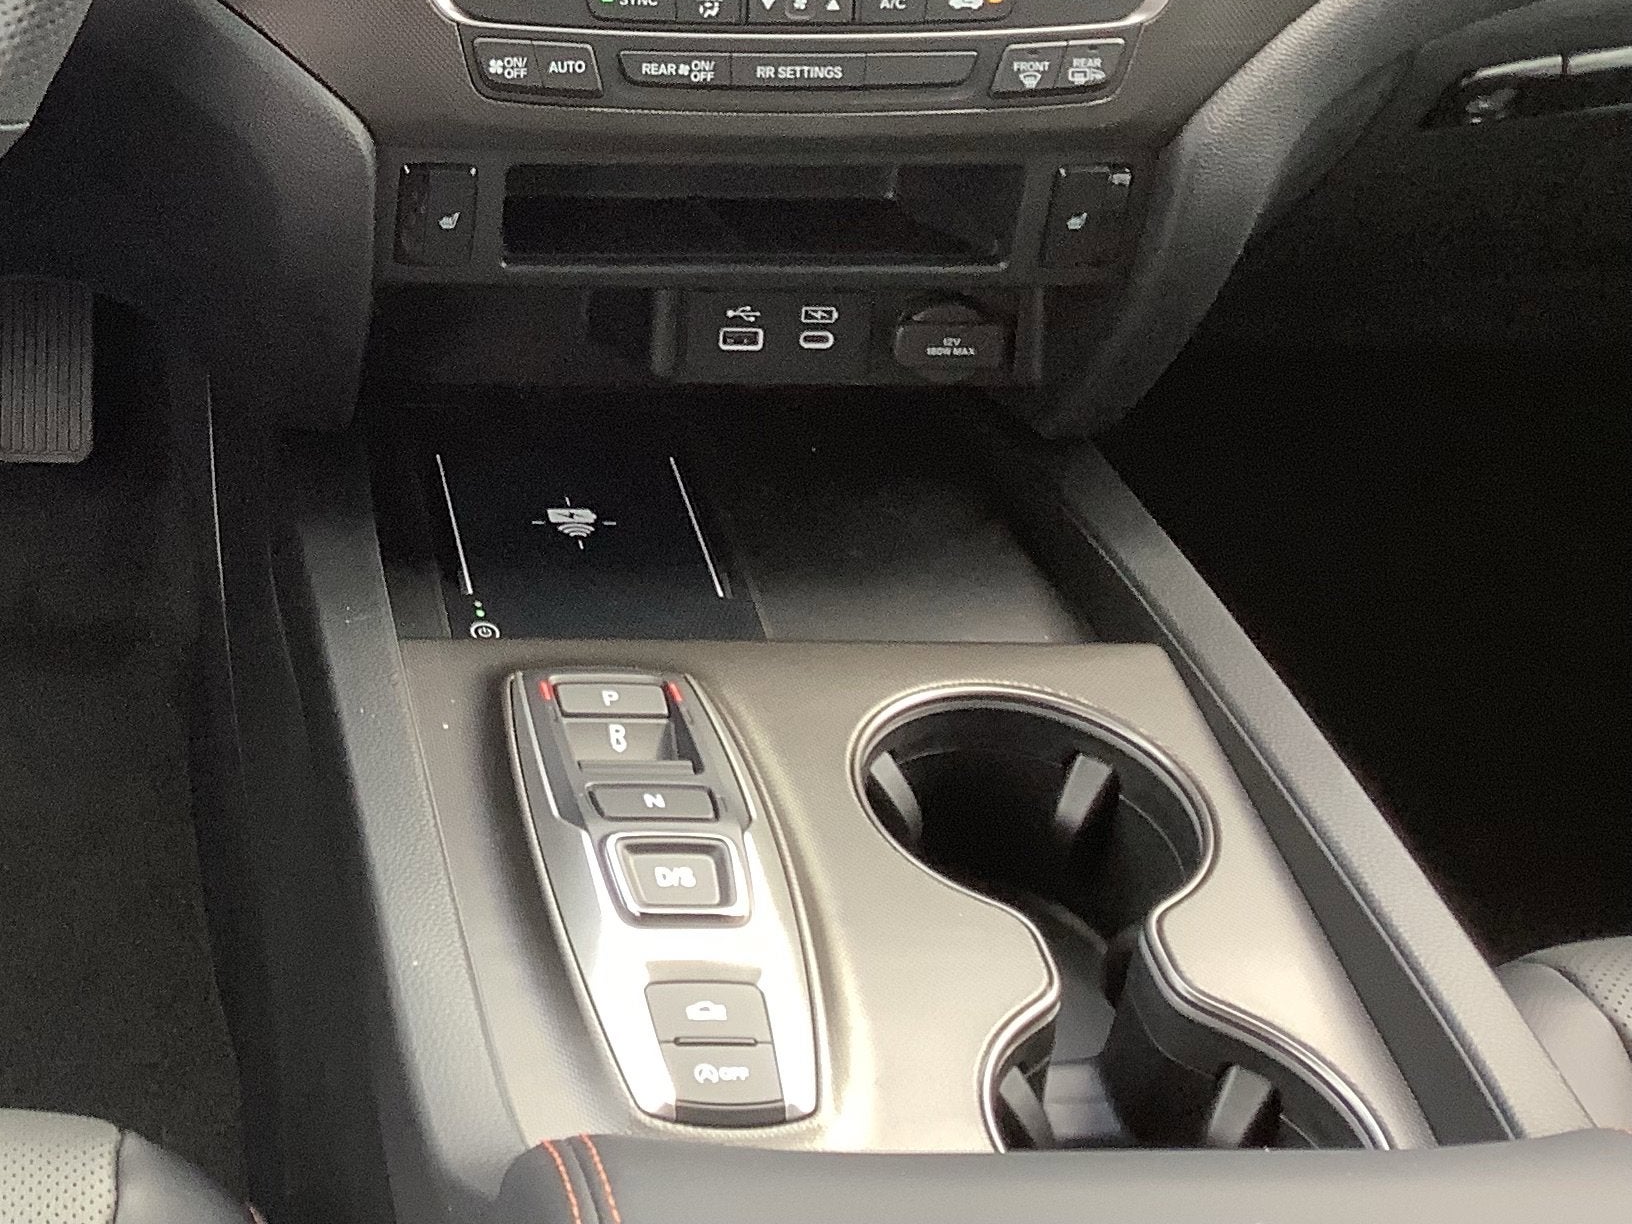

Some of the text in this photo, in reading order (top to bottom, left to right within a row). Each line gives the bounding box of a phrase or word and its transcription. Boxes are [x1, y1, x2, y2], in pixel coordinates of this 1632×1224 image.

[548, 60, 586, 74] AUTO
[641, 62, 677, 76] REAR
[1013, 61, 1050, 72] FRONT
[1072, 58, 1102, 68] REAR
[504, 68, 528, 79] OFF
[691, 71, 715, 83] OFF
[756, 66, 843, 79] RR SETTINGS
[601, 689, 620, 707] P
[643, 792, 667, 810] N
